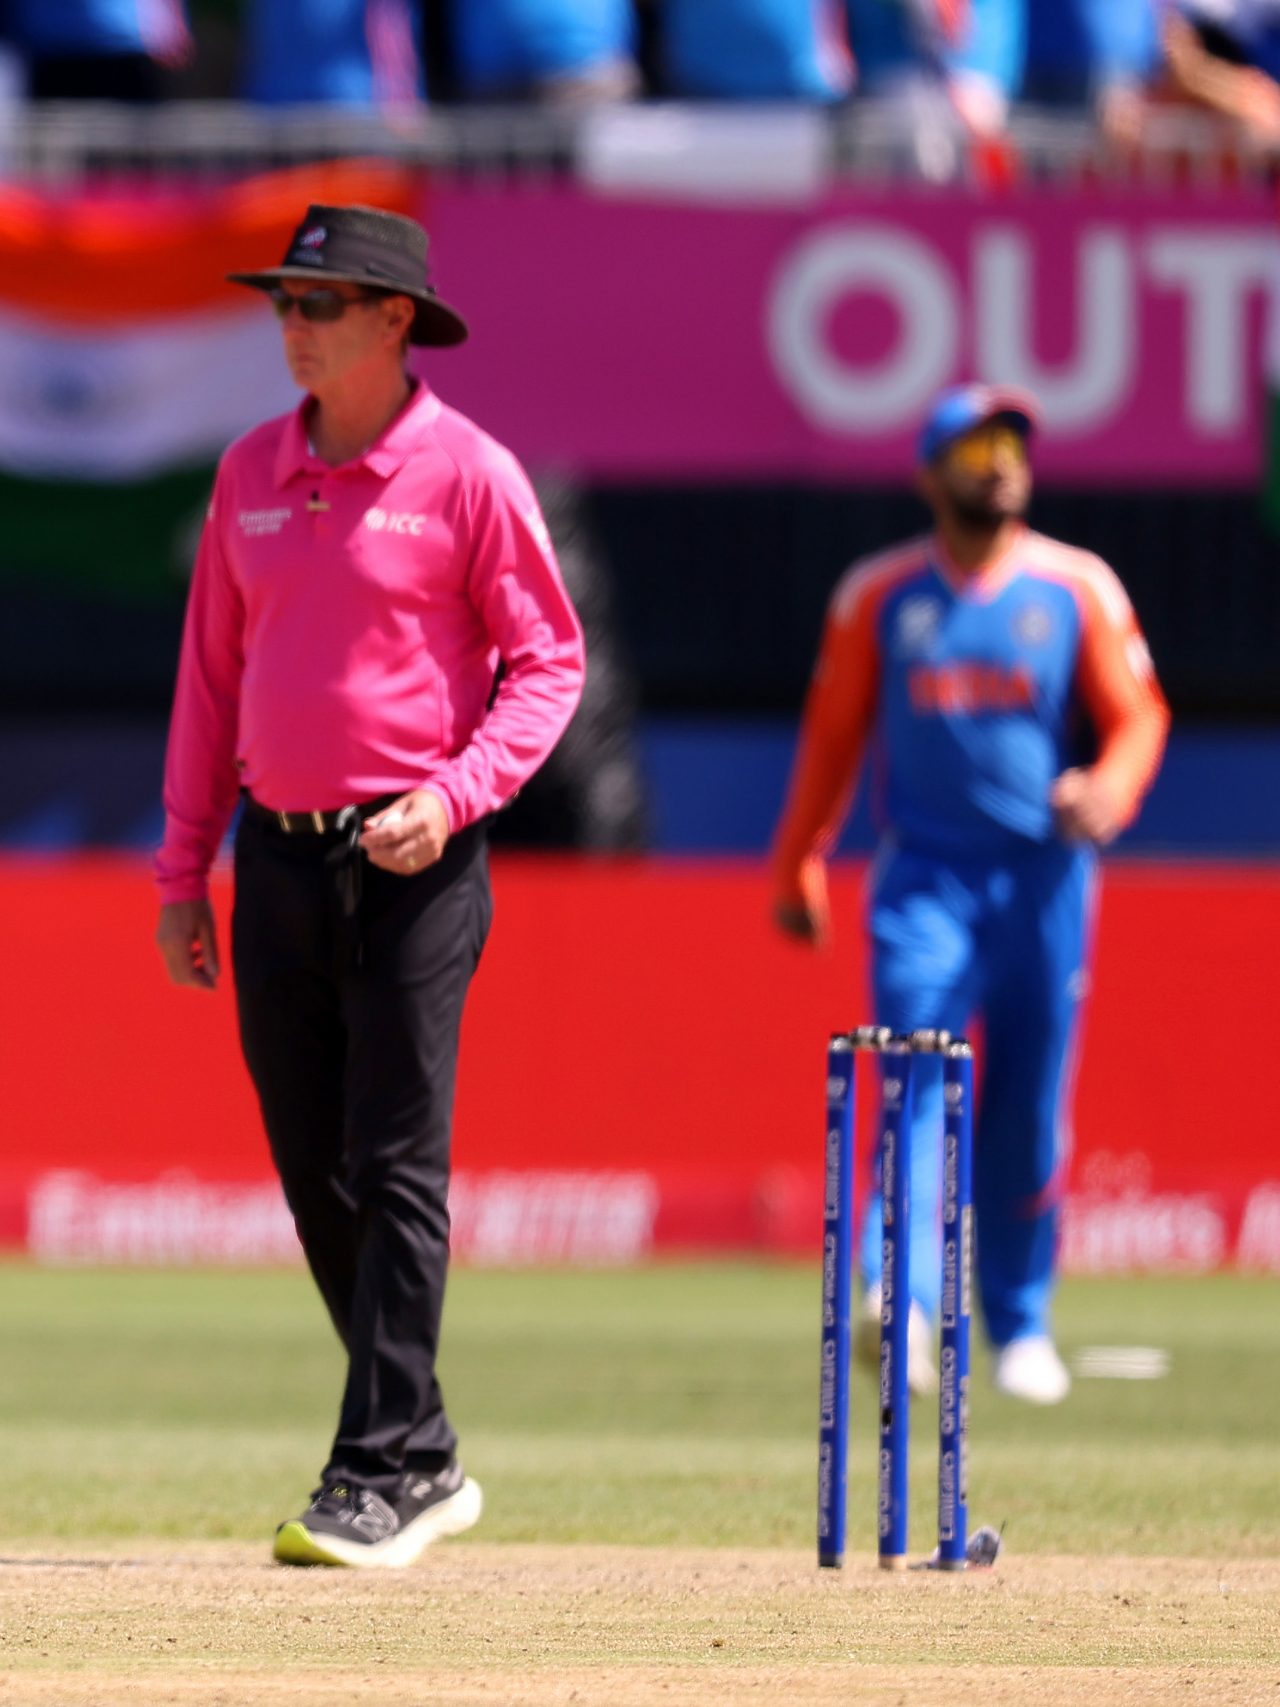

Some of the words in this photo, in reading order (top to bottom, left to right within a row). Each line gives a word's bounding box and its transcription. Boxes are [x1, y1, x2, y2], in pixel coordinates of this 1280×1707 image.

[763, 221, 1280, 440] OUT
[387, 512, 427, 537] ICC
[943, 1134, 958, 1225] aramco
[881, 1239, 894, 1326] aramco
[941, 1240, 956, 1328] Emirates
[820, 1339, 836, 1429] Emirates
[939, 1347, 955, 1435] aramco
[939, 1450, 954, 1541] Emirates
